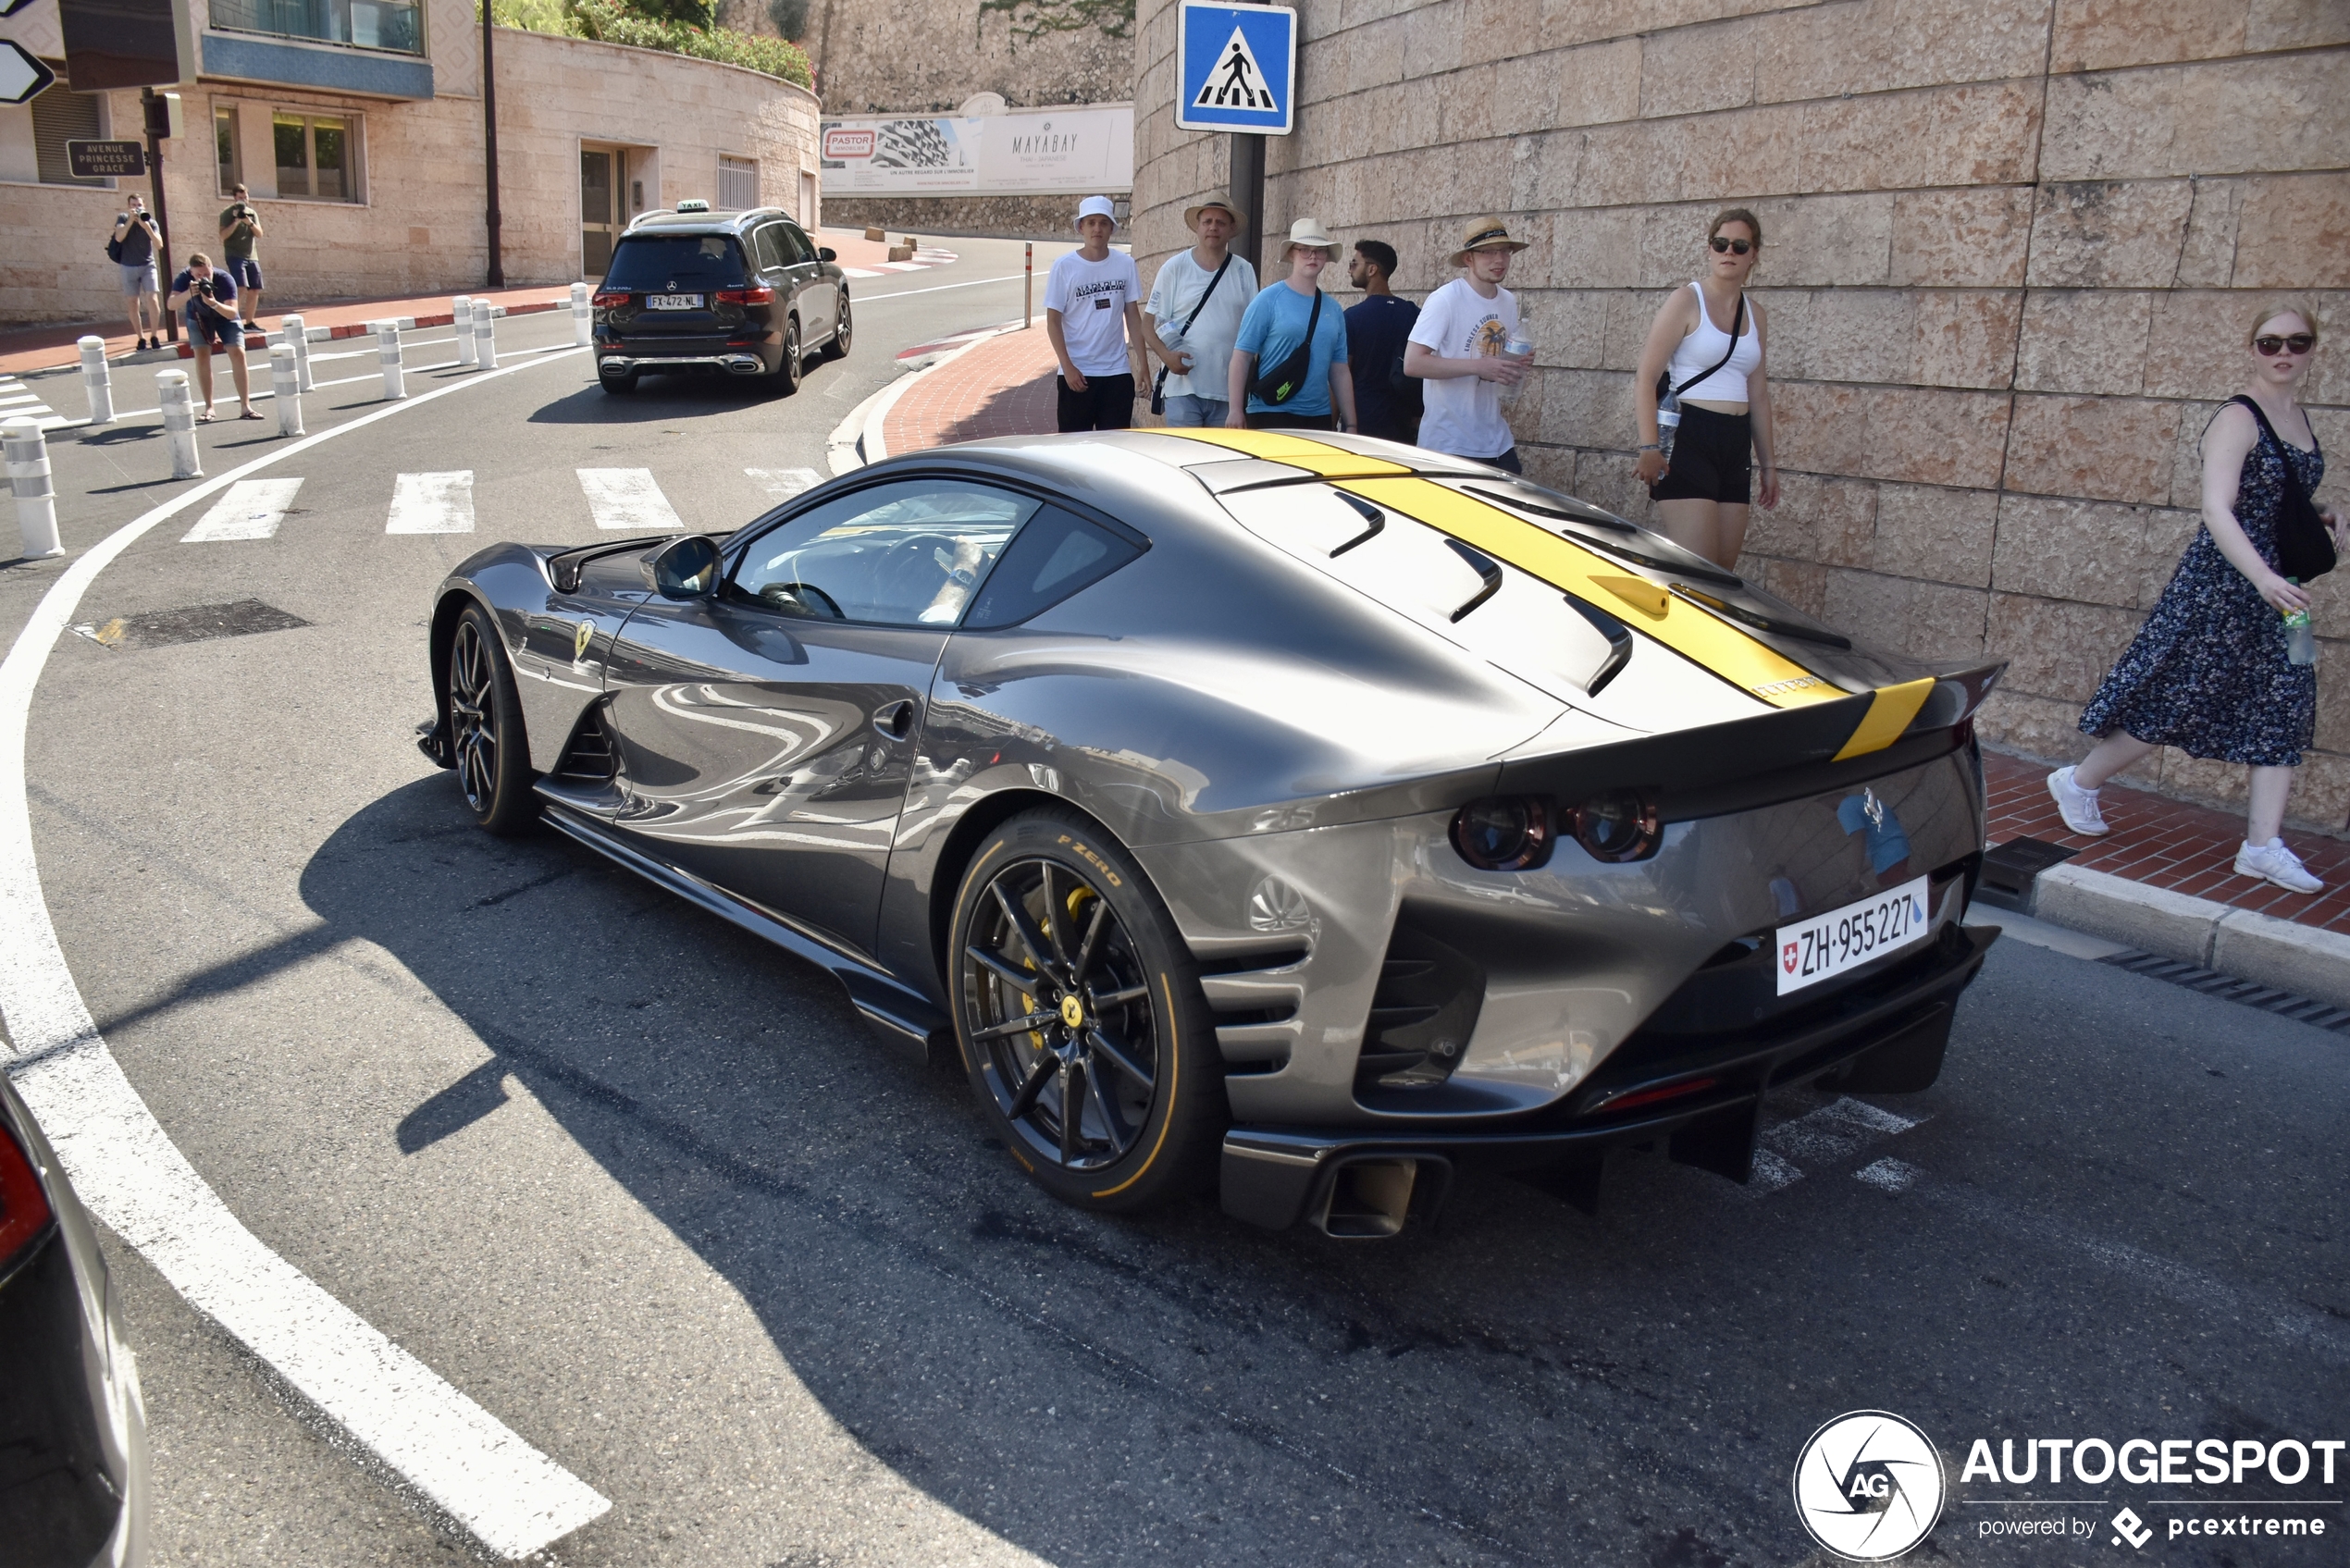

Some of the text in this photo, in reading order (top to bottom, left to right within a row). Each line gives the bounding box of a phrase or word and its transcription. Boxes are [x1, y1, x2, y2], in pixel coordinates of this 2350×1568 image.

[1012, 133, 1078, 154] MAYABAY
[93, 165, 125, 173] GRACE
[1465, 314, 1499, 352] ENDLESS SUMMER
[1058, 834, 1122, 887] P ZERO
